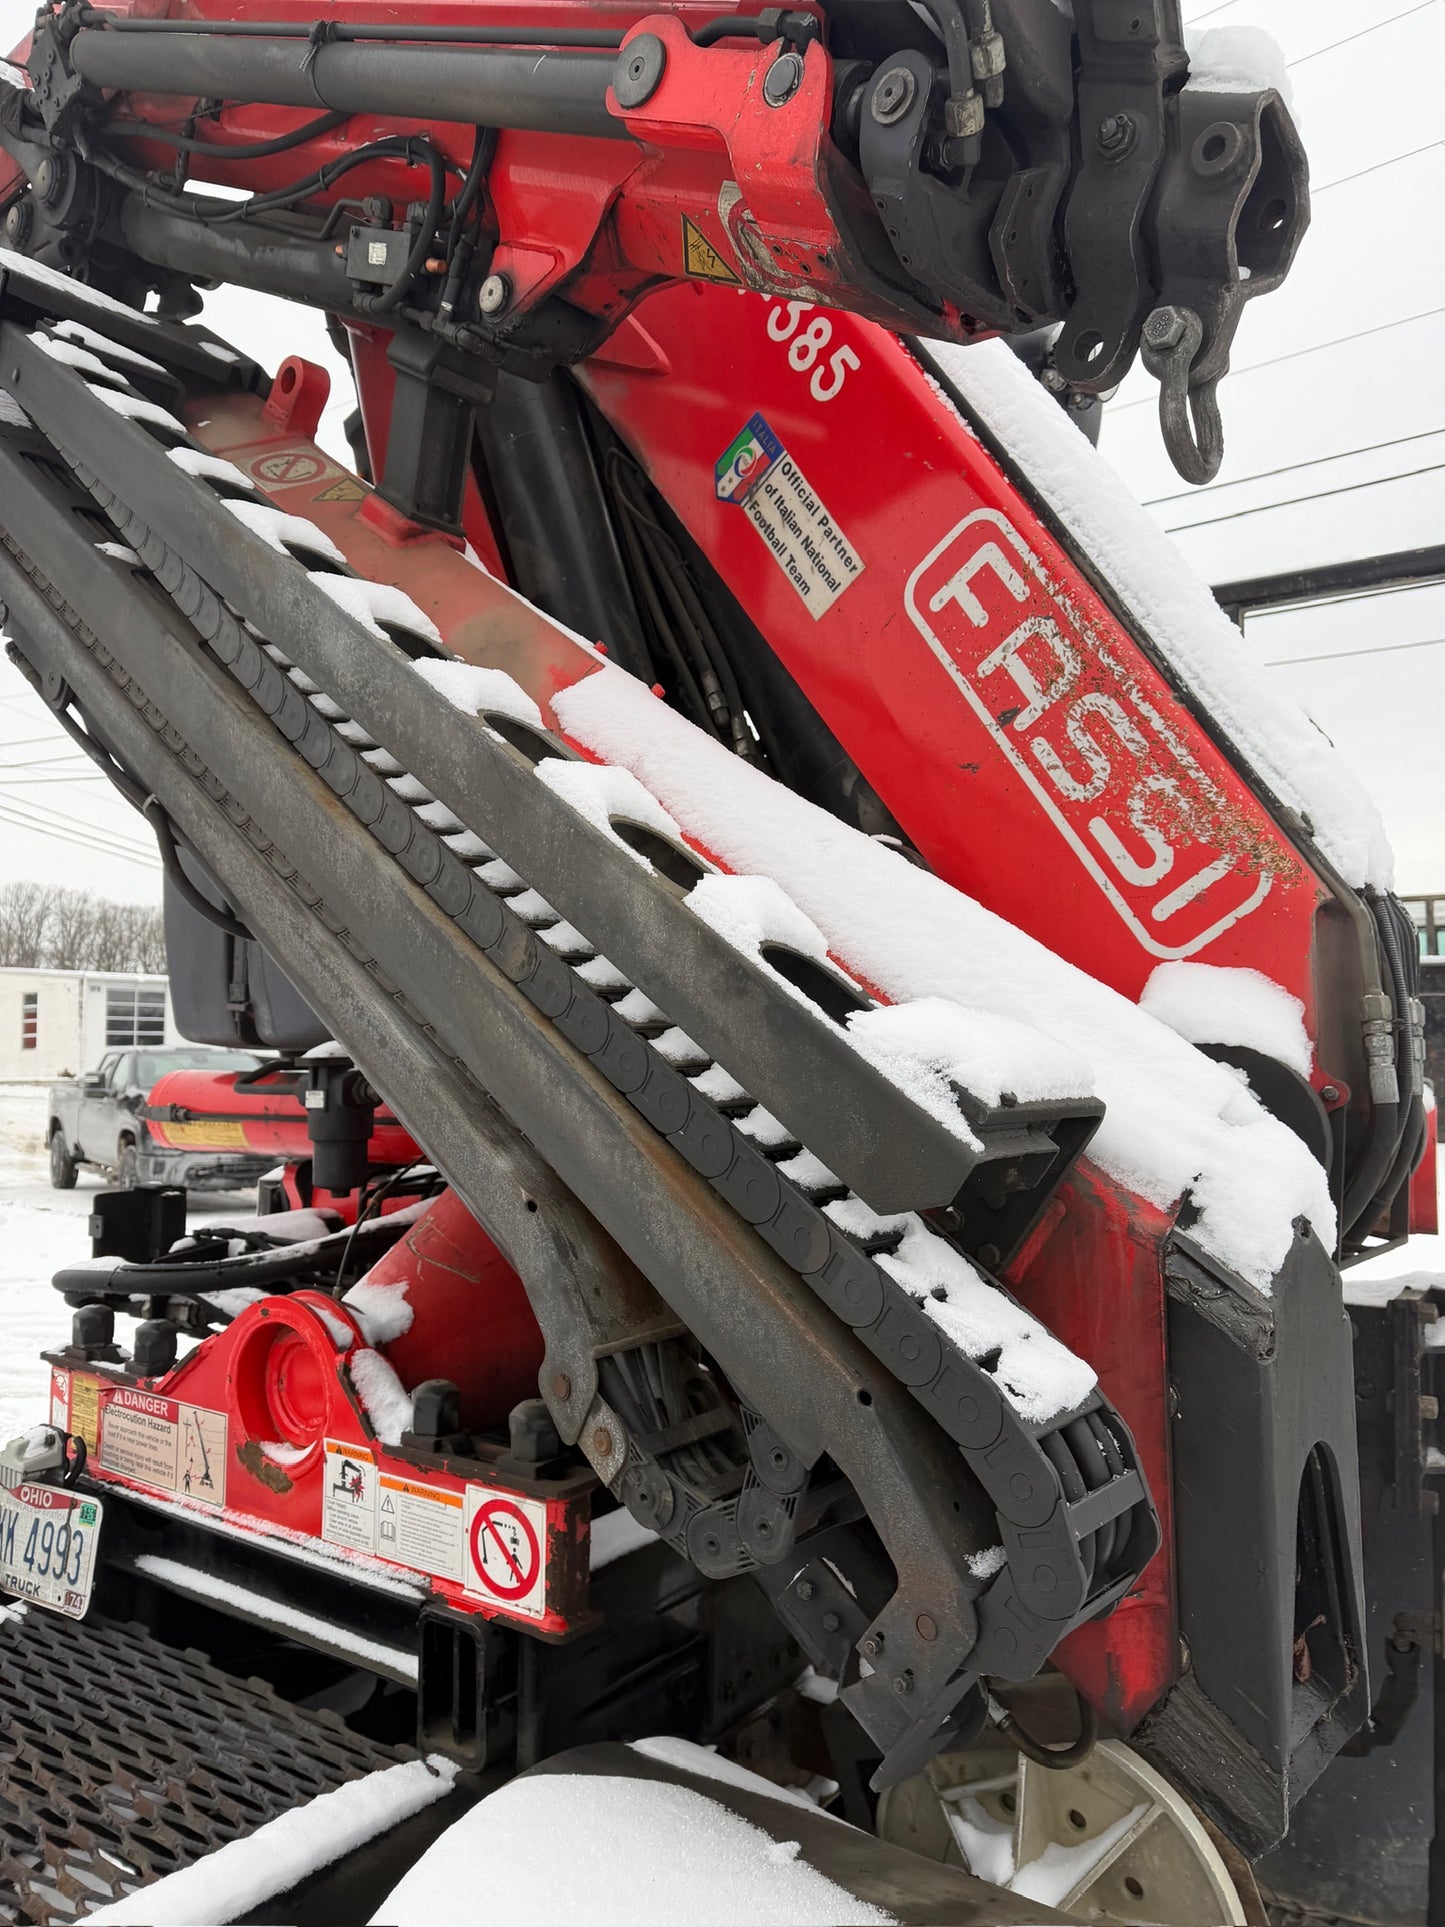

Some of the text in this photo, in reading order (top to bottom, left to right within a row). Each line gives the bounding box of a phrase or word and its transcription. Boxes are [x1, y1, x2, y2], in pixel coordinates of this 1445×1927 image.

[738, 289, 861, 402] 385
[753, 420, 777, 455] ITALIA
[781, 461, 858, 574] Official Partner
[748, 500, 811, 596] Football Team
[764, 483, 842, 593] of Italian National
[929, 541, 1237, 922] FASSI
[104, 1404, 171, 1434] Electrocution Hazard
[124, 1389, 169, 1417] DANGER
[342, 1448, 368, 1461] WARNING
[20, 1486, 52, 1507] OHIO
[410, 1486, 440, 1500] WARNING
[23, 1518, 84, 1586] 4993
[5, 1573, 41, 1597] TRUCK
